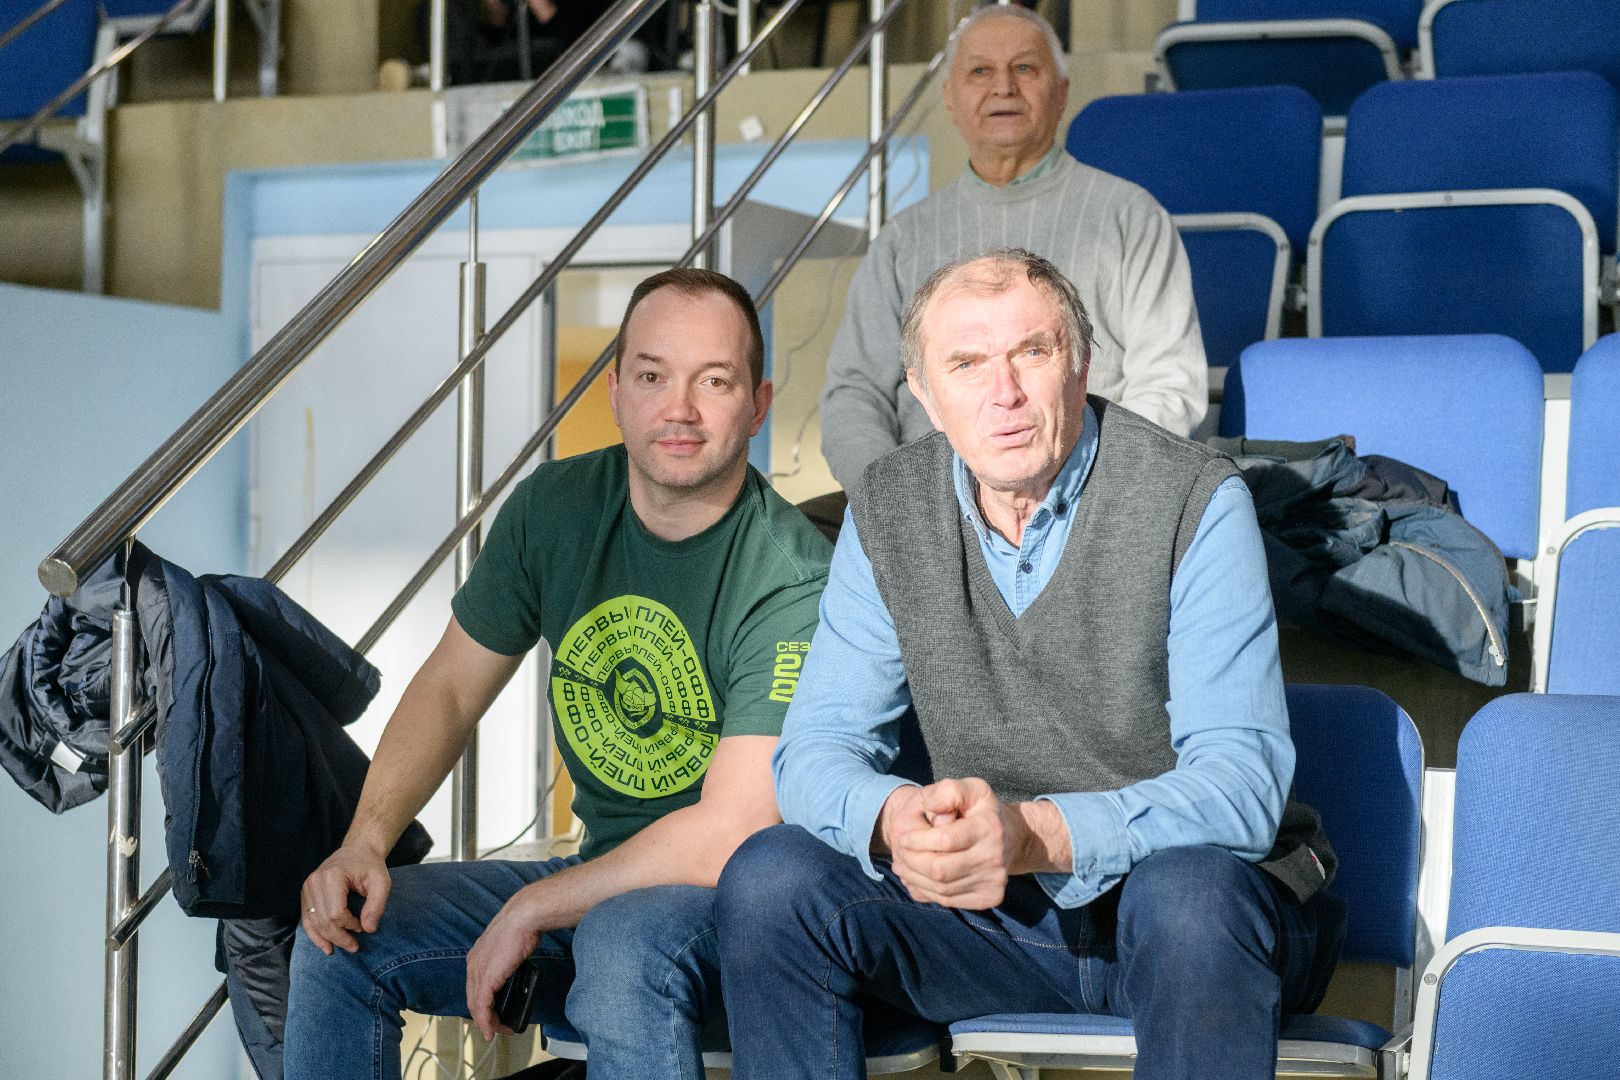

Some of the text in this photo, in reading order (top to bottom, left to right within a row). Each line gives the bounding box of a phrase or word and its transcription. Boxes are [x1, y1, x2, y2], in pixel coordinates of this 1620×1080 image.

[566, 605, 710, 719] ПЕРВЫ ПЛЕЙ-ОФФ
[581, 625, 692, 716] ПЕРВЫ ПЛЕЙ-ОФФ
[776, 641, 811, 652] СЕЗ
[563, 682, 645, 792] ПЛЕЙ-ОФФ
[580, 686, 643, 772] ПЛЕЙ-ОФФ
